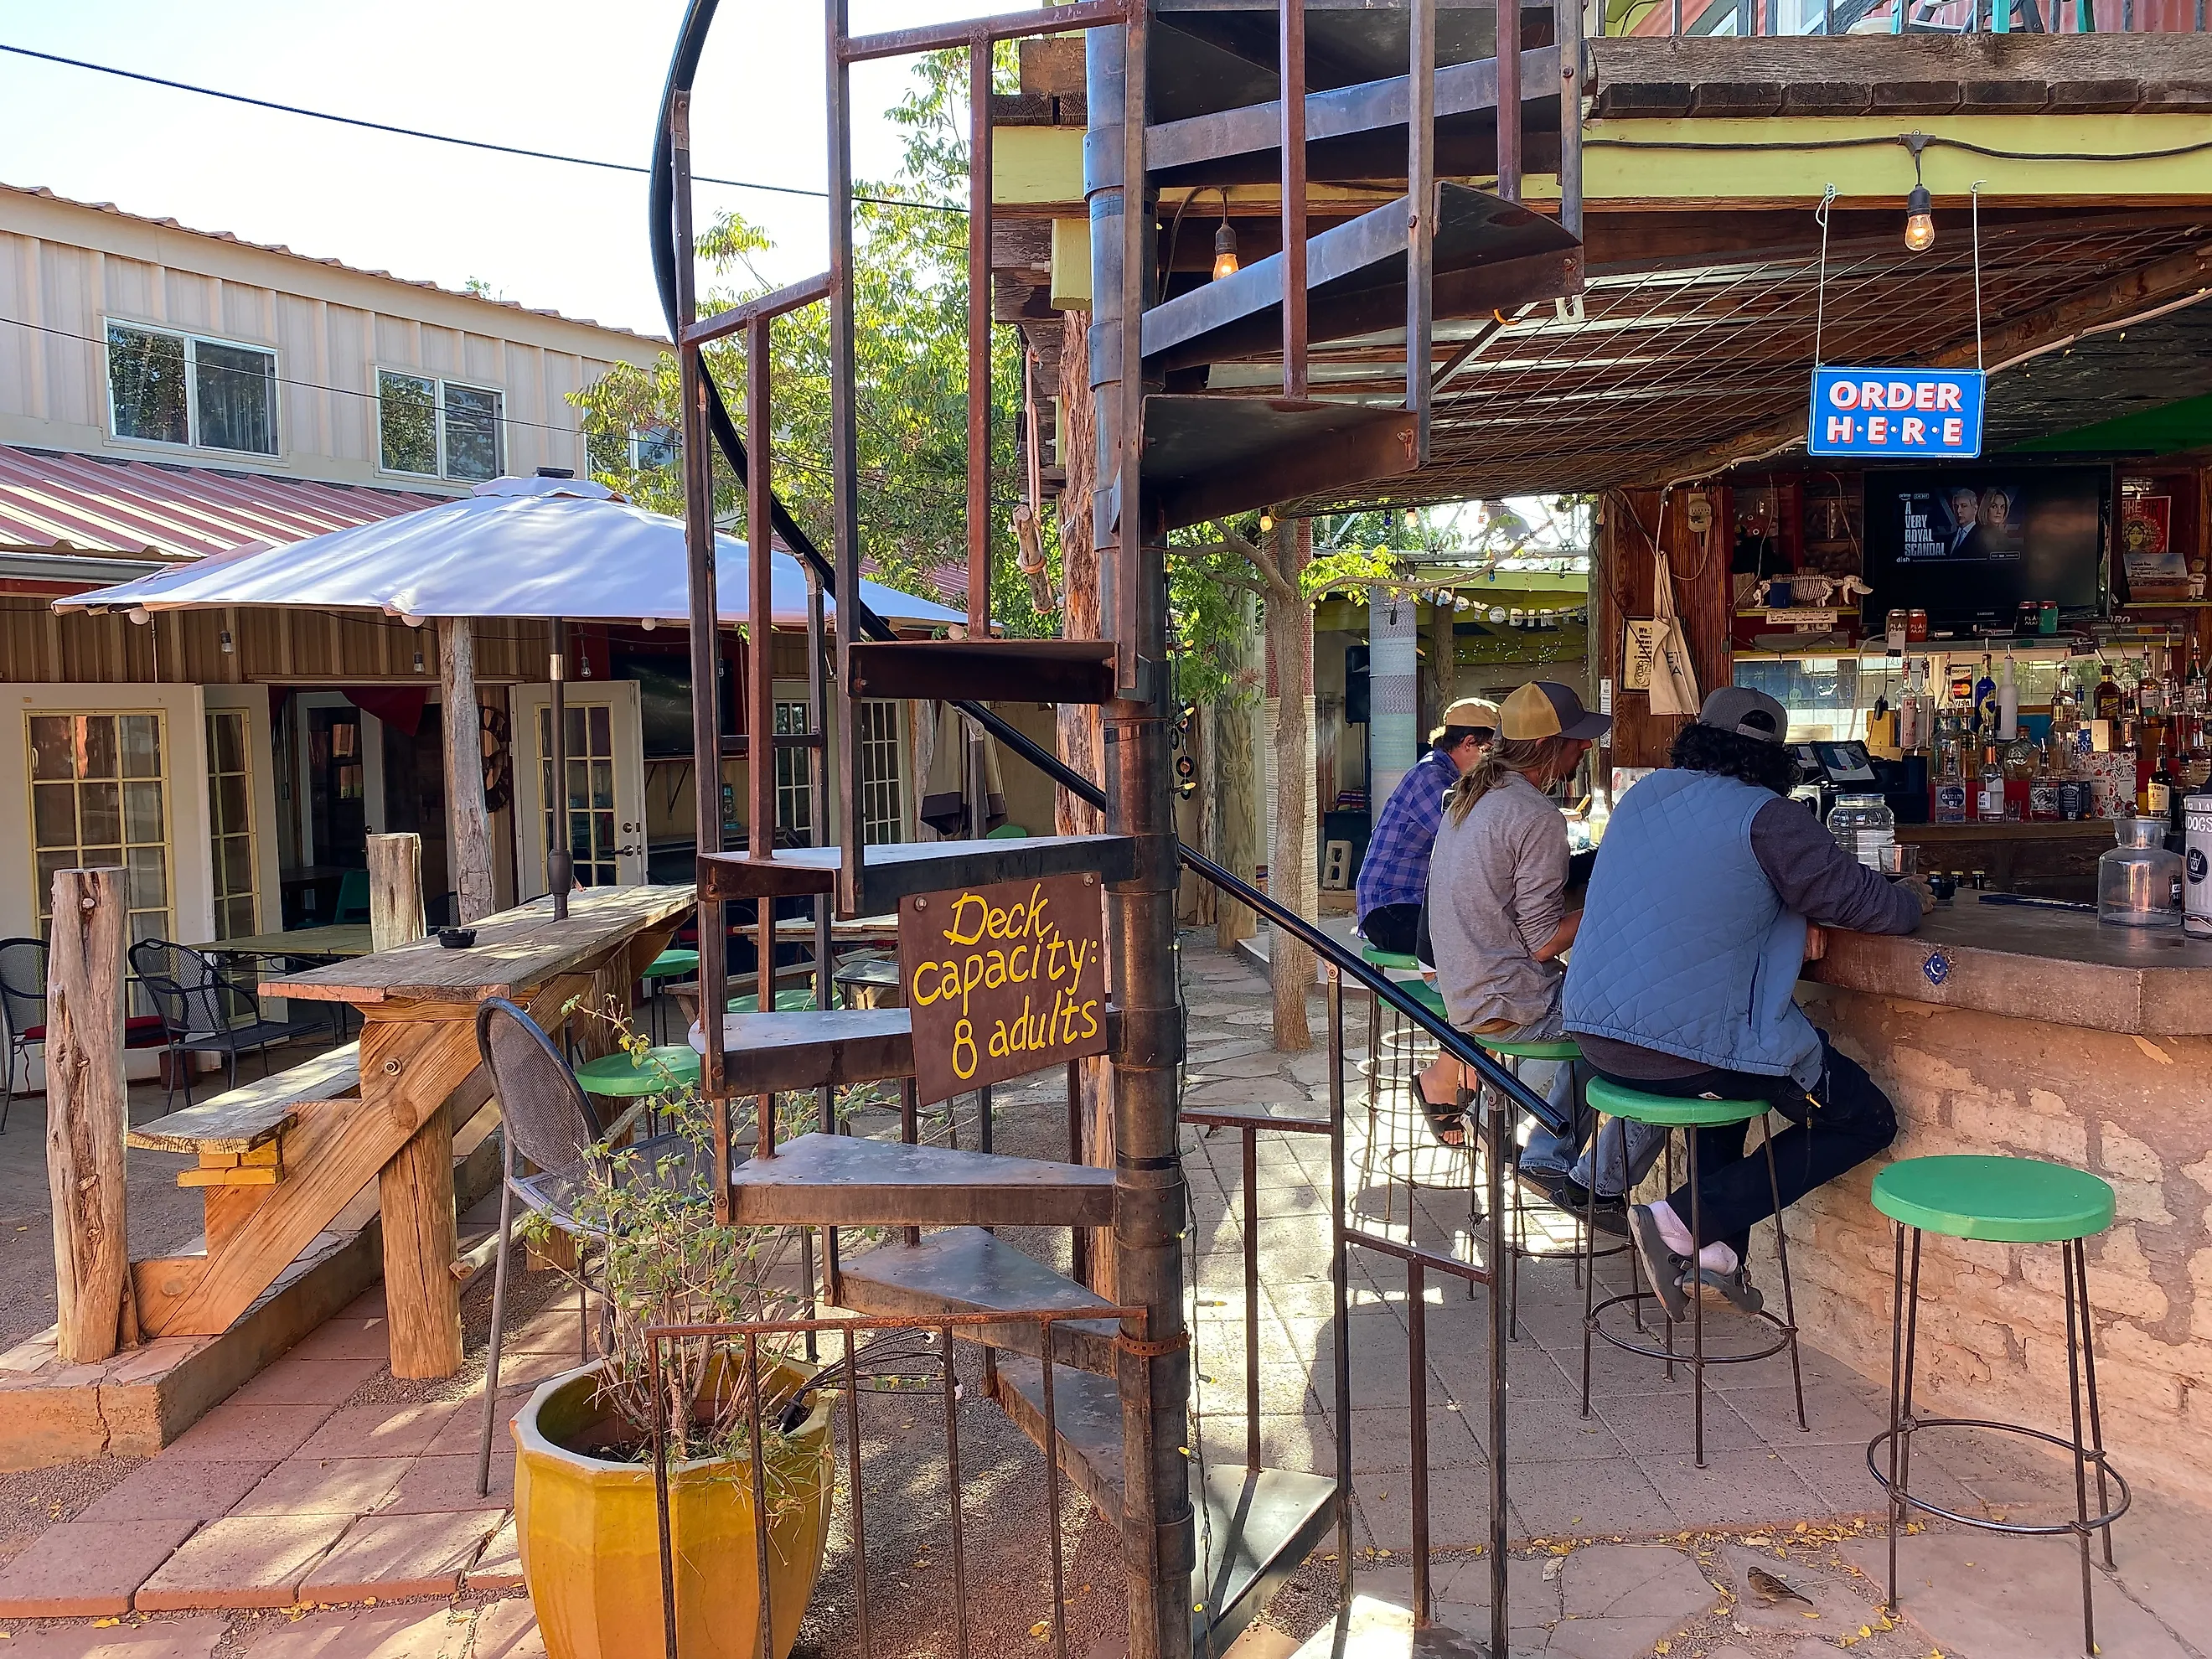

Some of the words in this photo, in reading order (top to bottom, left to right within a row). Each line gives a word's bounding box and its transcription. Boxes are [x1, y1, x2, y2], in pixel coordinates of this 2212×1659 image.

[1829, 380, 1963, 411] ORDER
[1904, 501, 1911, 514] A
[1904, 514, 1927, 528] VERY
[1904, 529, 1934, 542] ROYAL
[1904, 543, 1946, 556] SCANDAL
[943, 882, 1054, 946] Deck
[912, 929, 1098, 1016] capacity:
[952, 1018, 979, 1080] 8
[988, 990, 1098, 1057] adults
